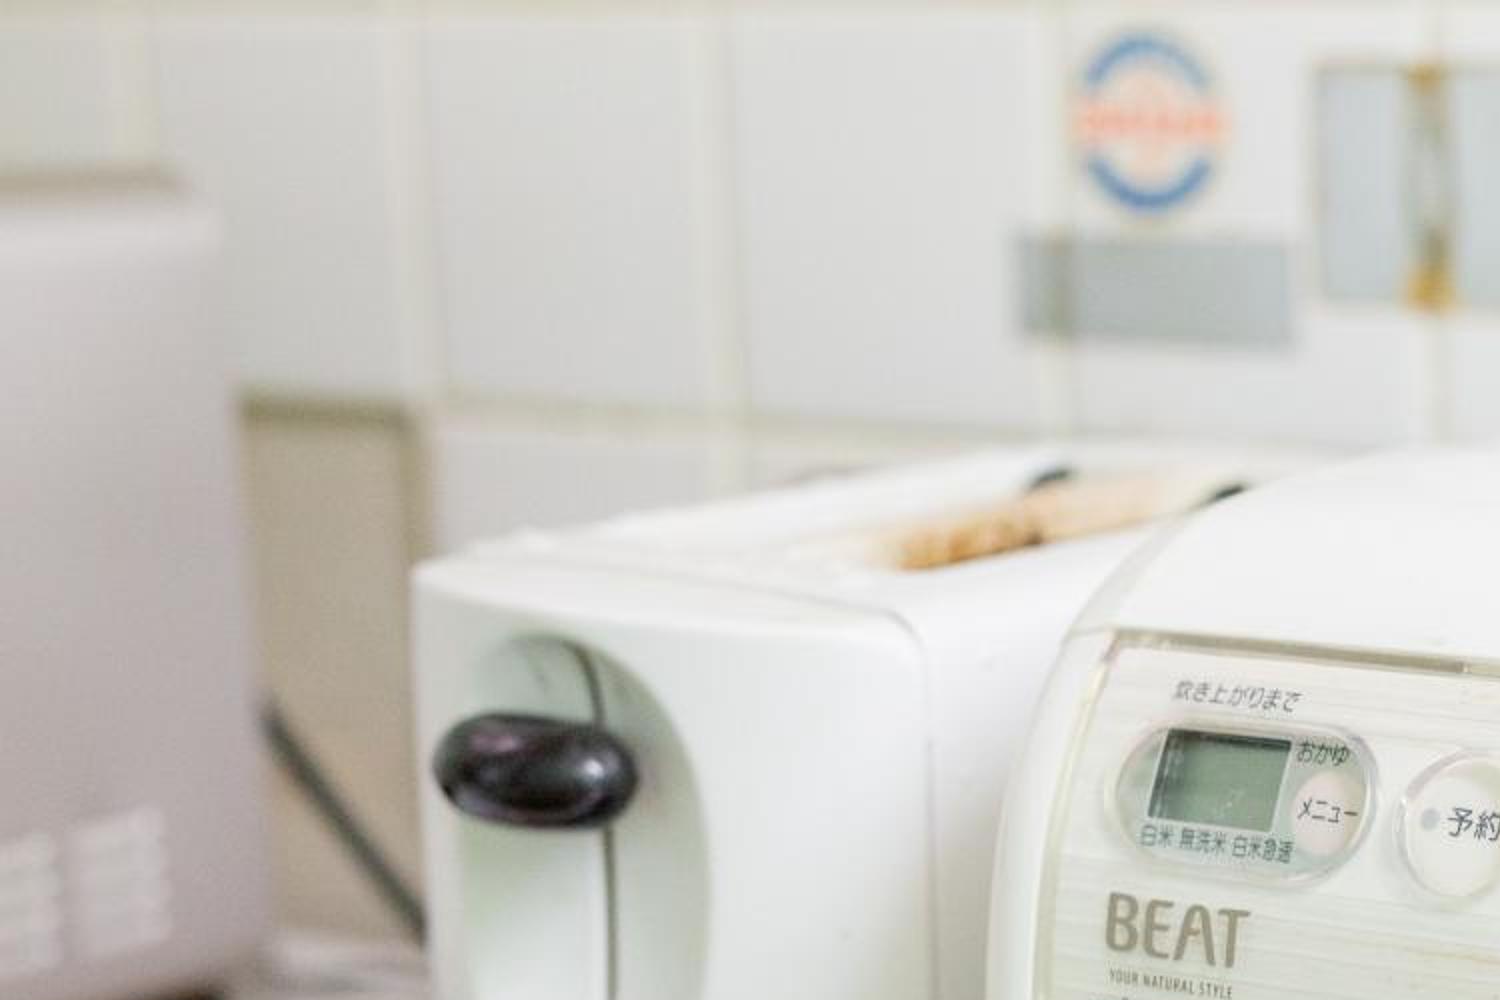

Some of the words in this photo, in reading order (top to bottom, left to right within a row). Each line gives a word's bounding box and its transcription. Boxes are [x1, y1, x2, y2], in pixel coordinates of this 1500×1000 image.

[1174, 681, 1302, 712] 炊き上がりまで
[1297, 740, 1350, 766] おかゆ
[1297, 797, 1358, 824] メニュー
[1140, 824, 1173, 848] 白米
[1106, 891, 1251, 968] BEAT
[1110, 967, 1139, 985] YOUR
[1143, 973, 1195, 996] NATURAL
[1199, 981, 1233, 1000] STYLE
